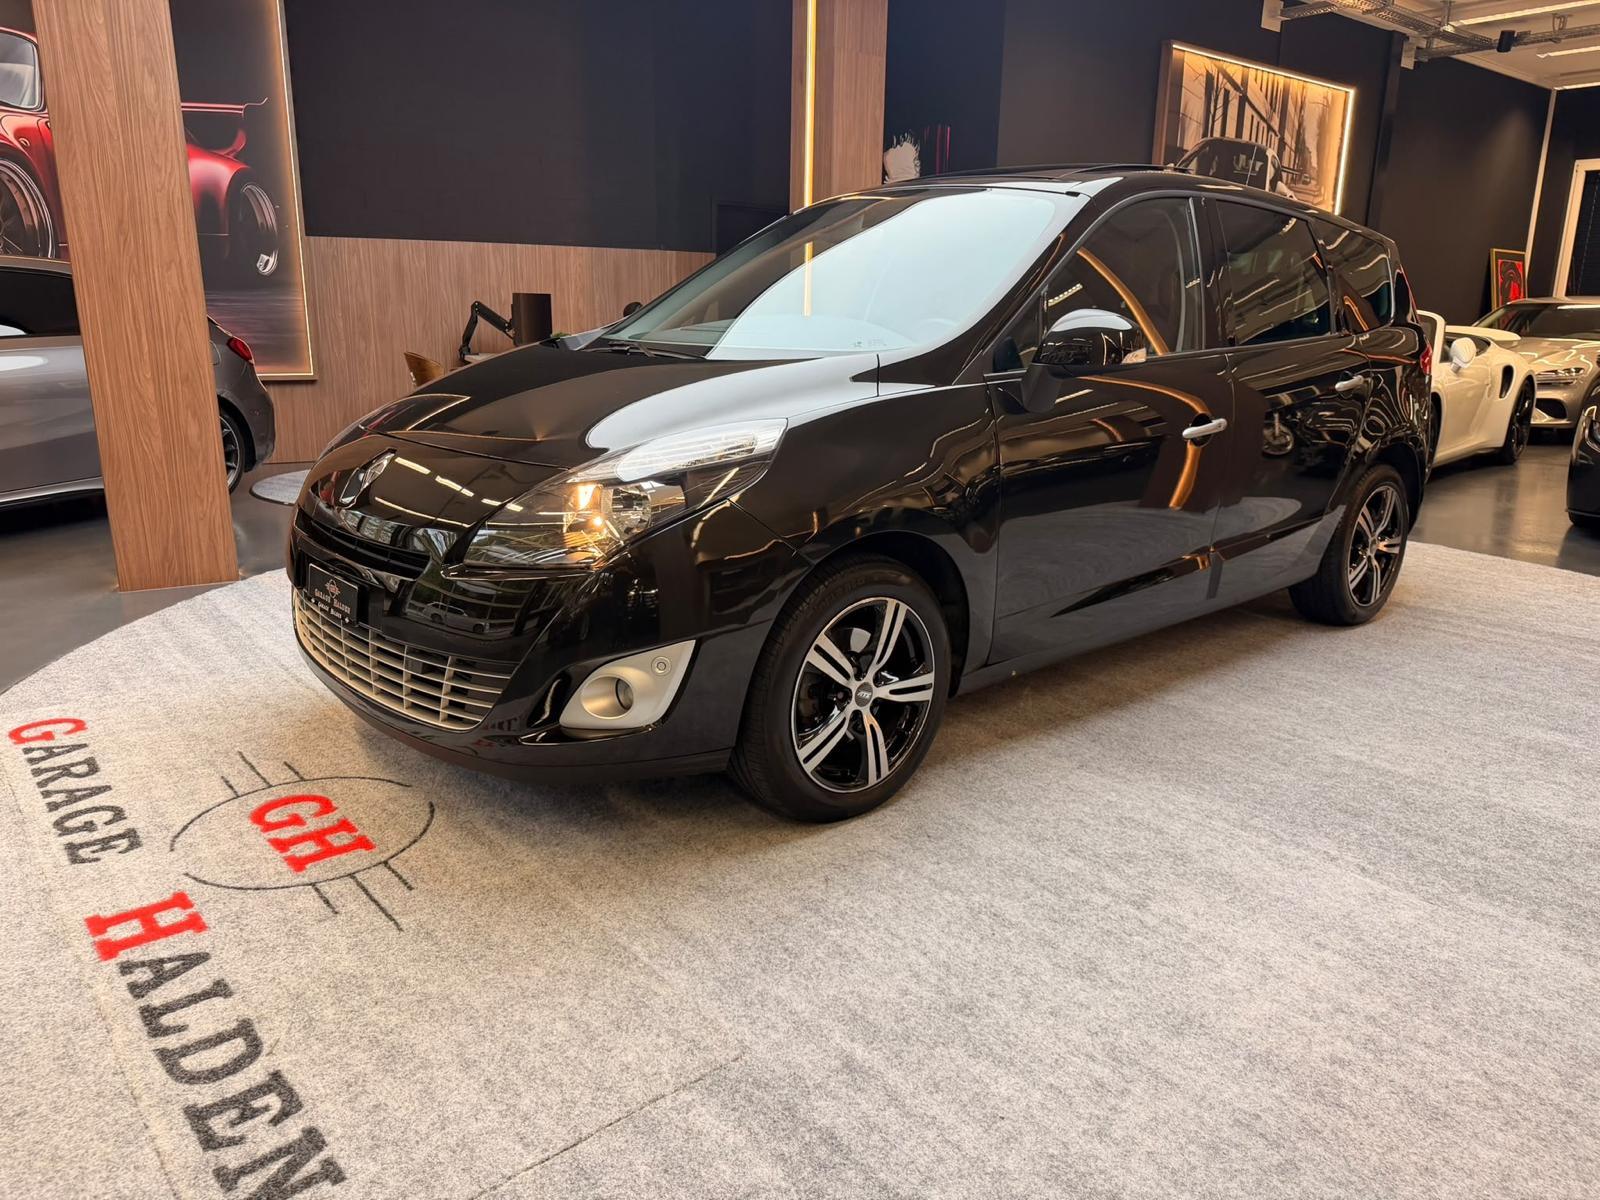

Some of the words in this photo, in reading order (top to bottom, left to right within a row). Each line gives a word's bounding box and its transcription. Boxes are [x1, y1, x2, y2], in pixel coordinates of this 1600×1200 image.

[8, 717, 143, 865] GARAGE
[85, 891, 347, 1200] HALDEN
[248, 794, 377, 873] GH
